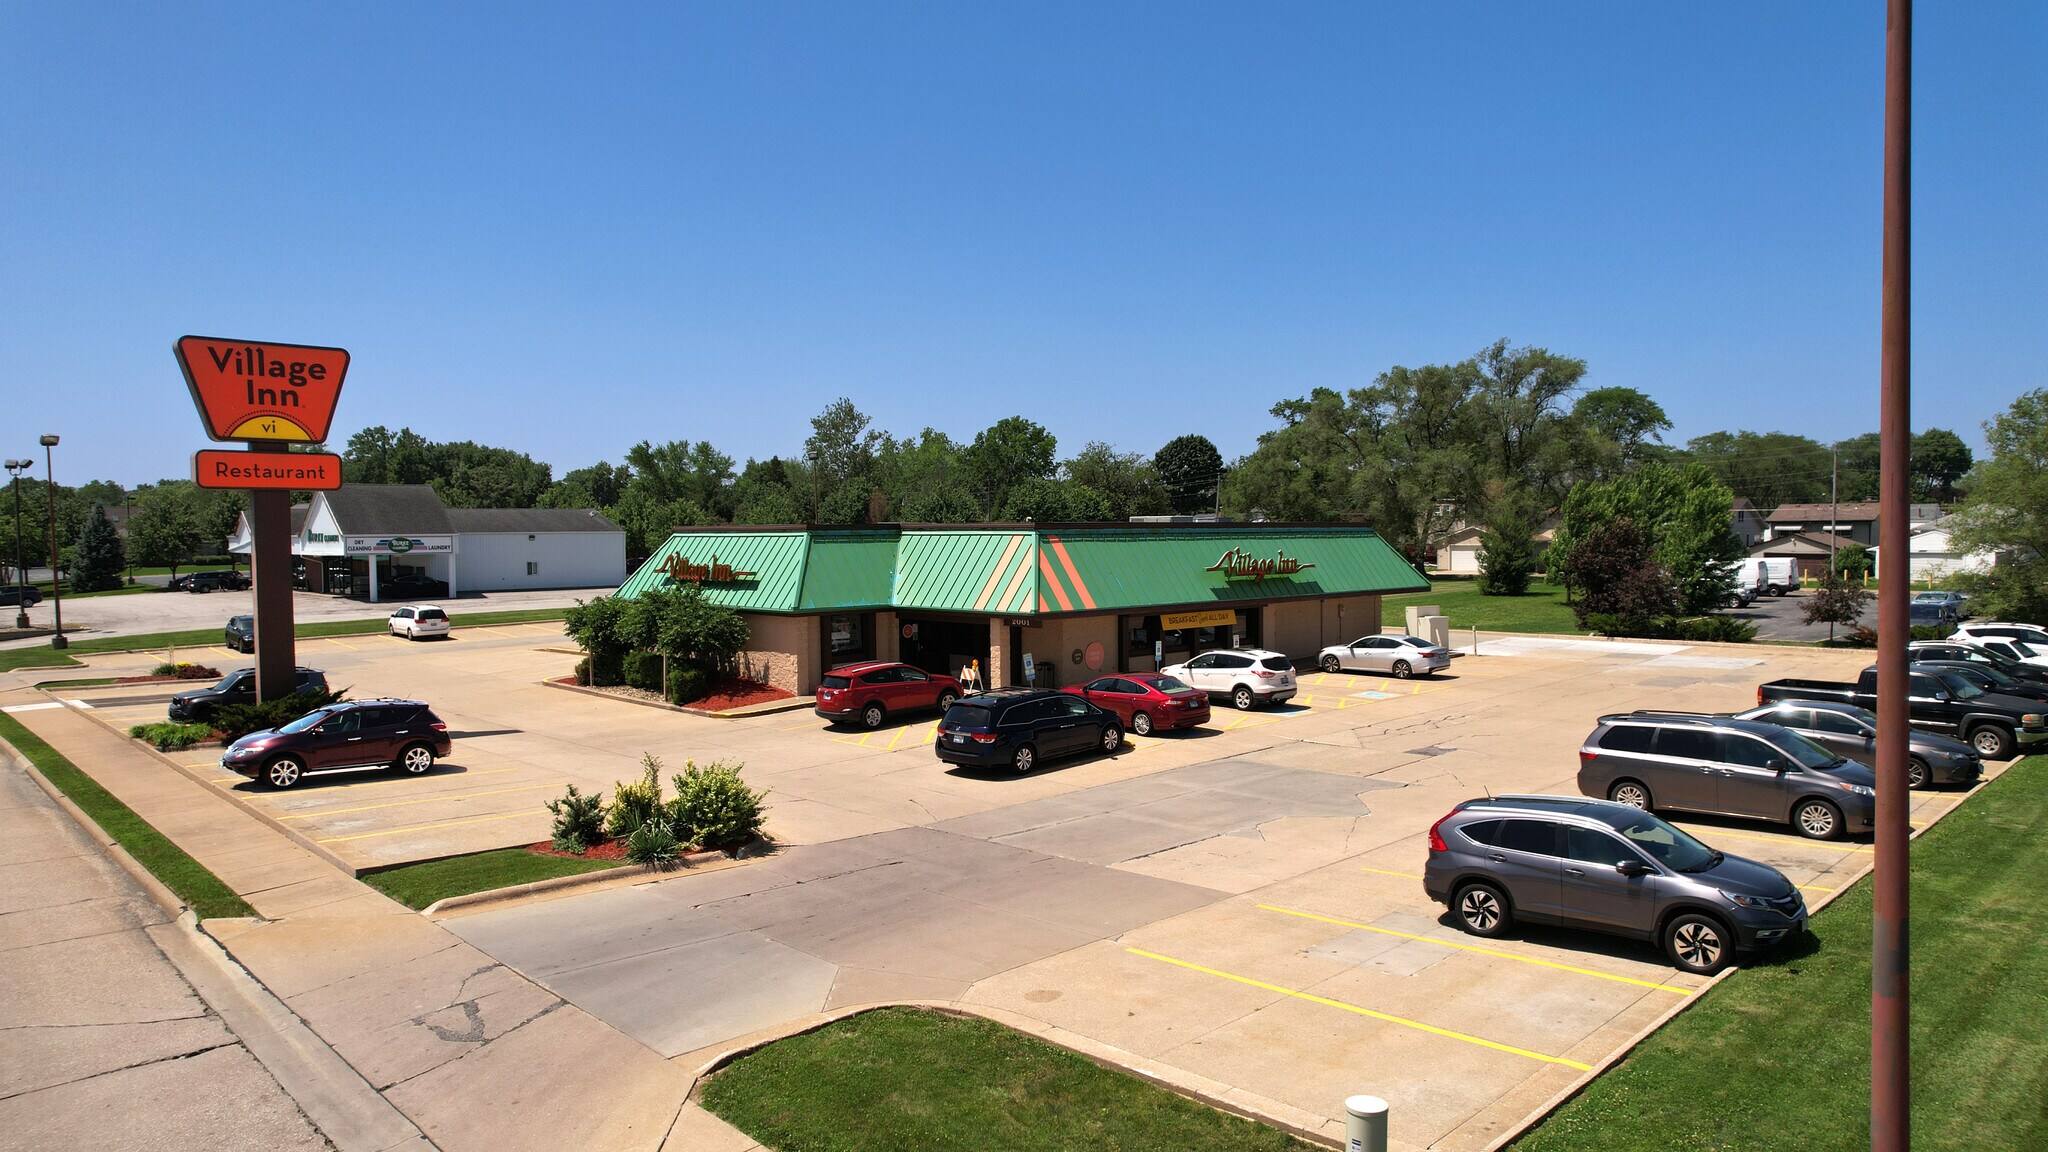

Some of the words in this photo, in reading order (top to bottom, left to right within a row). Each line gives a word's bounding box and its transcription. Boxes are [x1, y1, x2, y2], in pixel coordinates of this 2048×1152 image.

[207, 346, 327, 387] Village
[247, 379, 299, 407] Inn
[261, 420, 276, 433] vi
[216, 462, 325, 480] Restaurant
[655, 551, 709, 583] Village
[711, 554, 750, 582] Inn
[1206, 546, 1275, 584] Village
[1277, 549, 1314, 574] Inn
[1011, 618, 1030, 626] 2001
[1168, 615, 1198, 625] BREAKFAST
[1219, 612, 1229, 621] DAY
